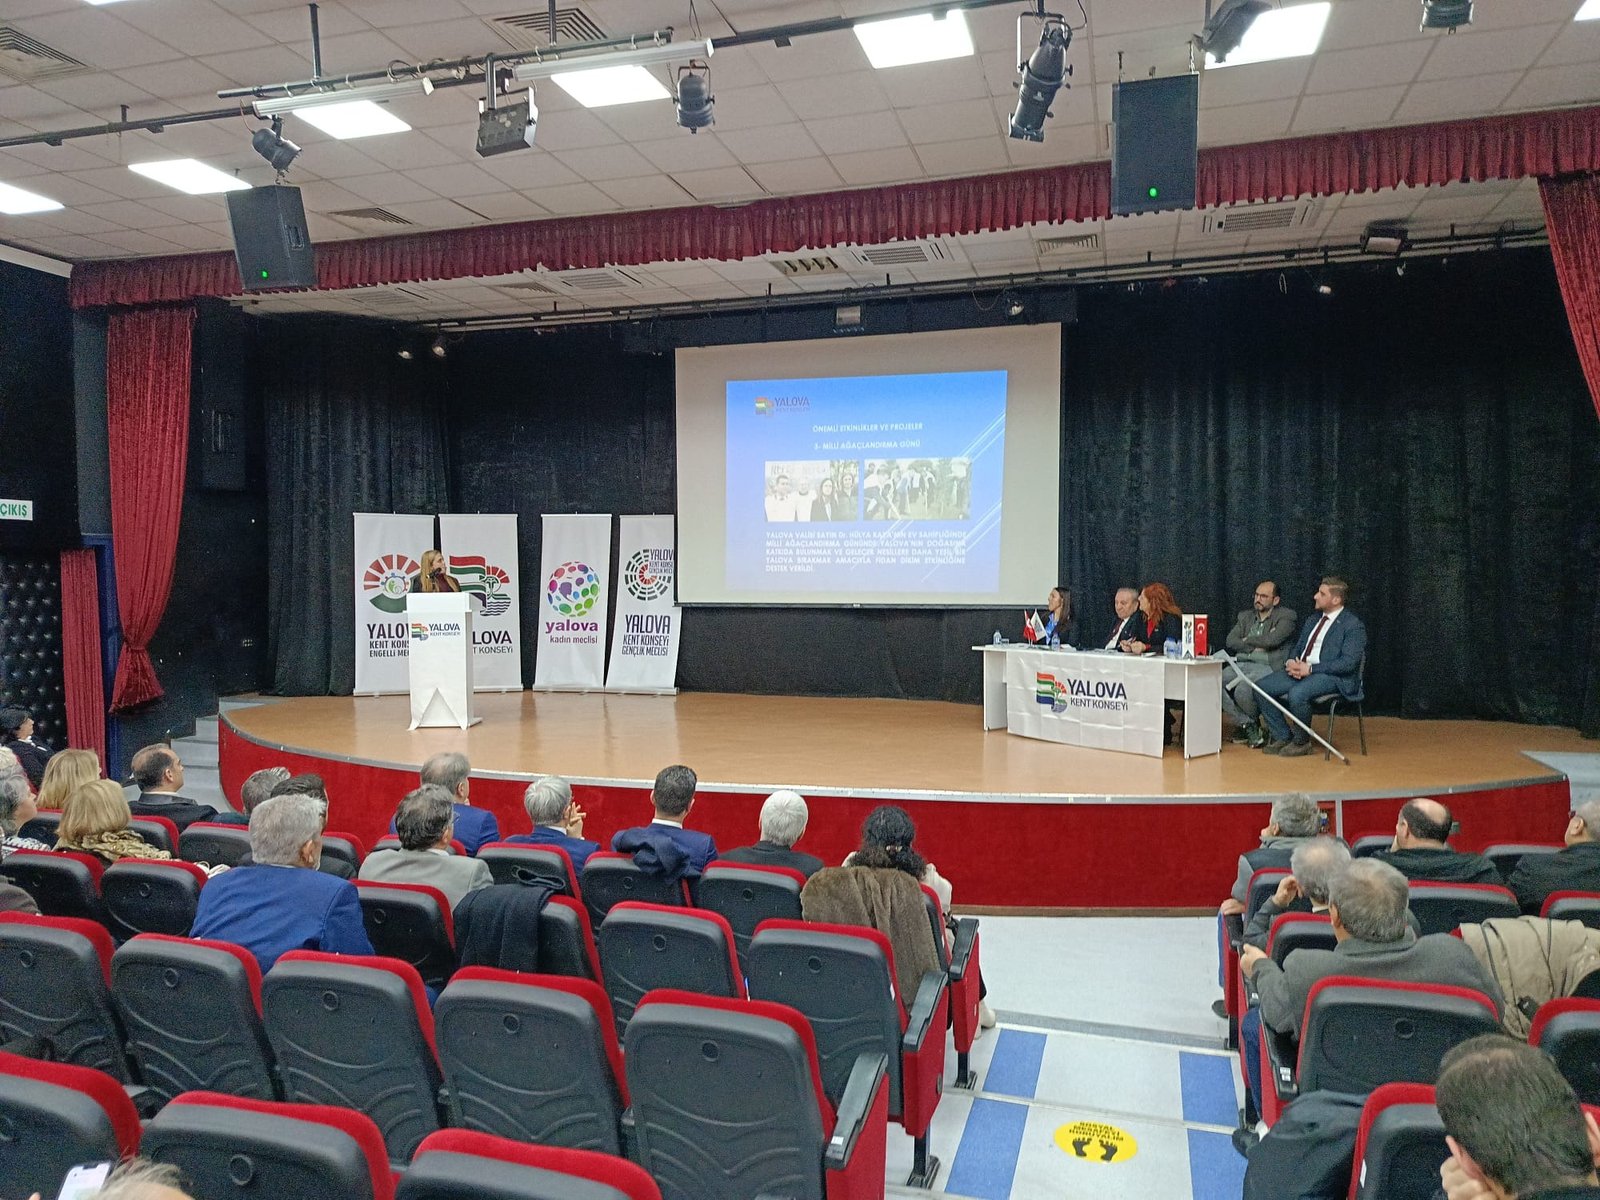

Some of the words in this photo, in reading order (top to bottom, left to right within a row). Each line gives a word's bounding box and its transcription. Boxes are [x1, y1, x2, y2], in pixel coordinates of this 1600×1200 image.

[775, 396, 810, 407] YALOVA
[880, 423, 889, 431] VE
[890, 422, 923, 430] PROJELER
[650, 549, 673, 561] YALOV
[428, 623, 461, 631] YALOVA
[545, 619, 598, 634] yalova
[625, 614, 671, 634] YALOVA
[367, 623, 409, 639] YALO
[472, 630, 513, 645] LOVA
[550, 635, 571, 644] kadın
[573, 635, 598, 645] meclisi
[623, 634, 640, 646] KENT
[370, 640, 388, 649] KENT
[1067, 678, 1127, 700] YALOVA
[1070, 697, 1091, 708] KENT
